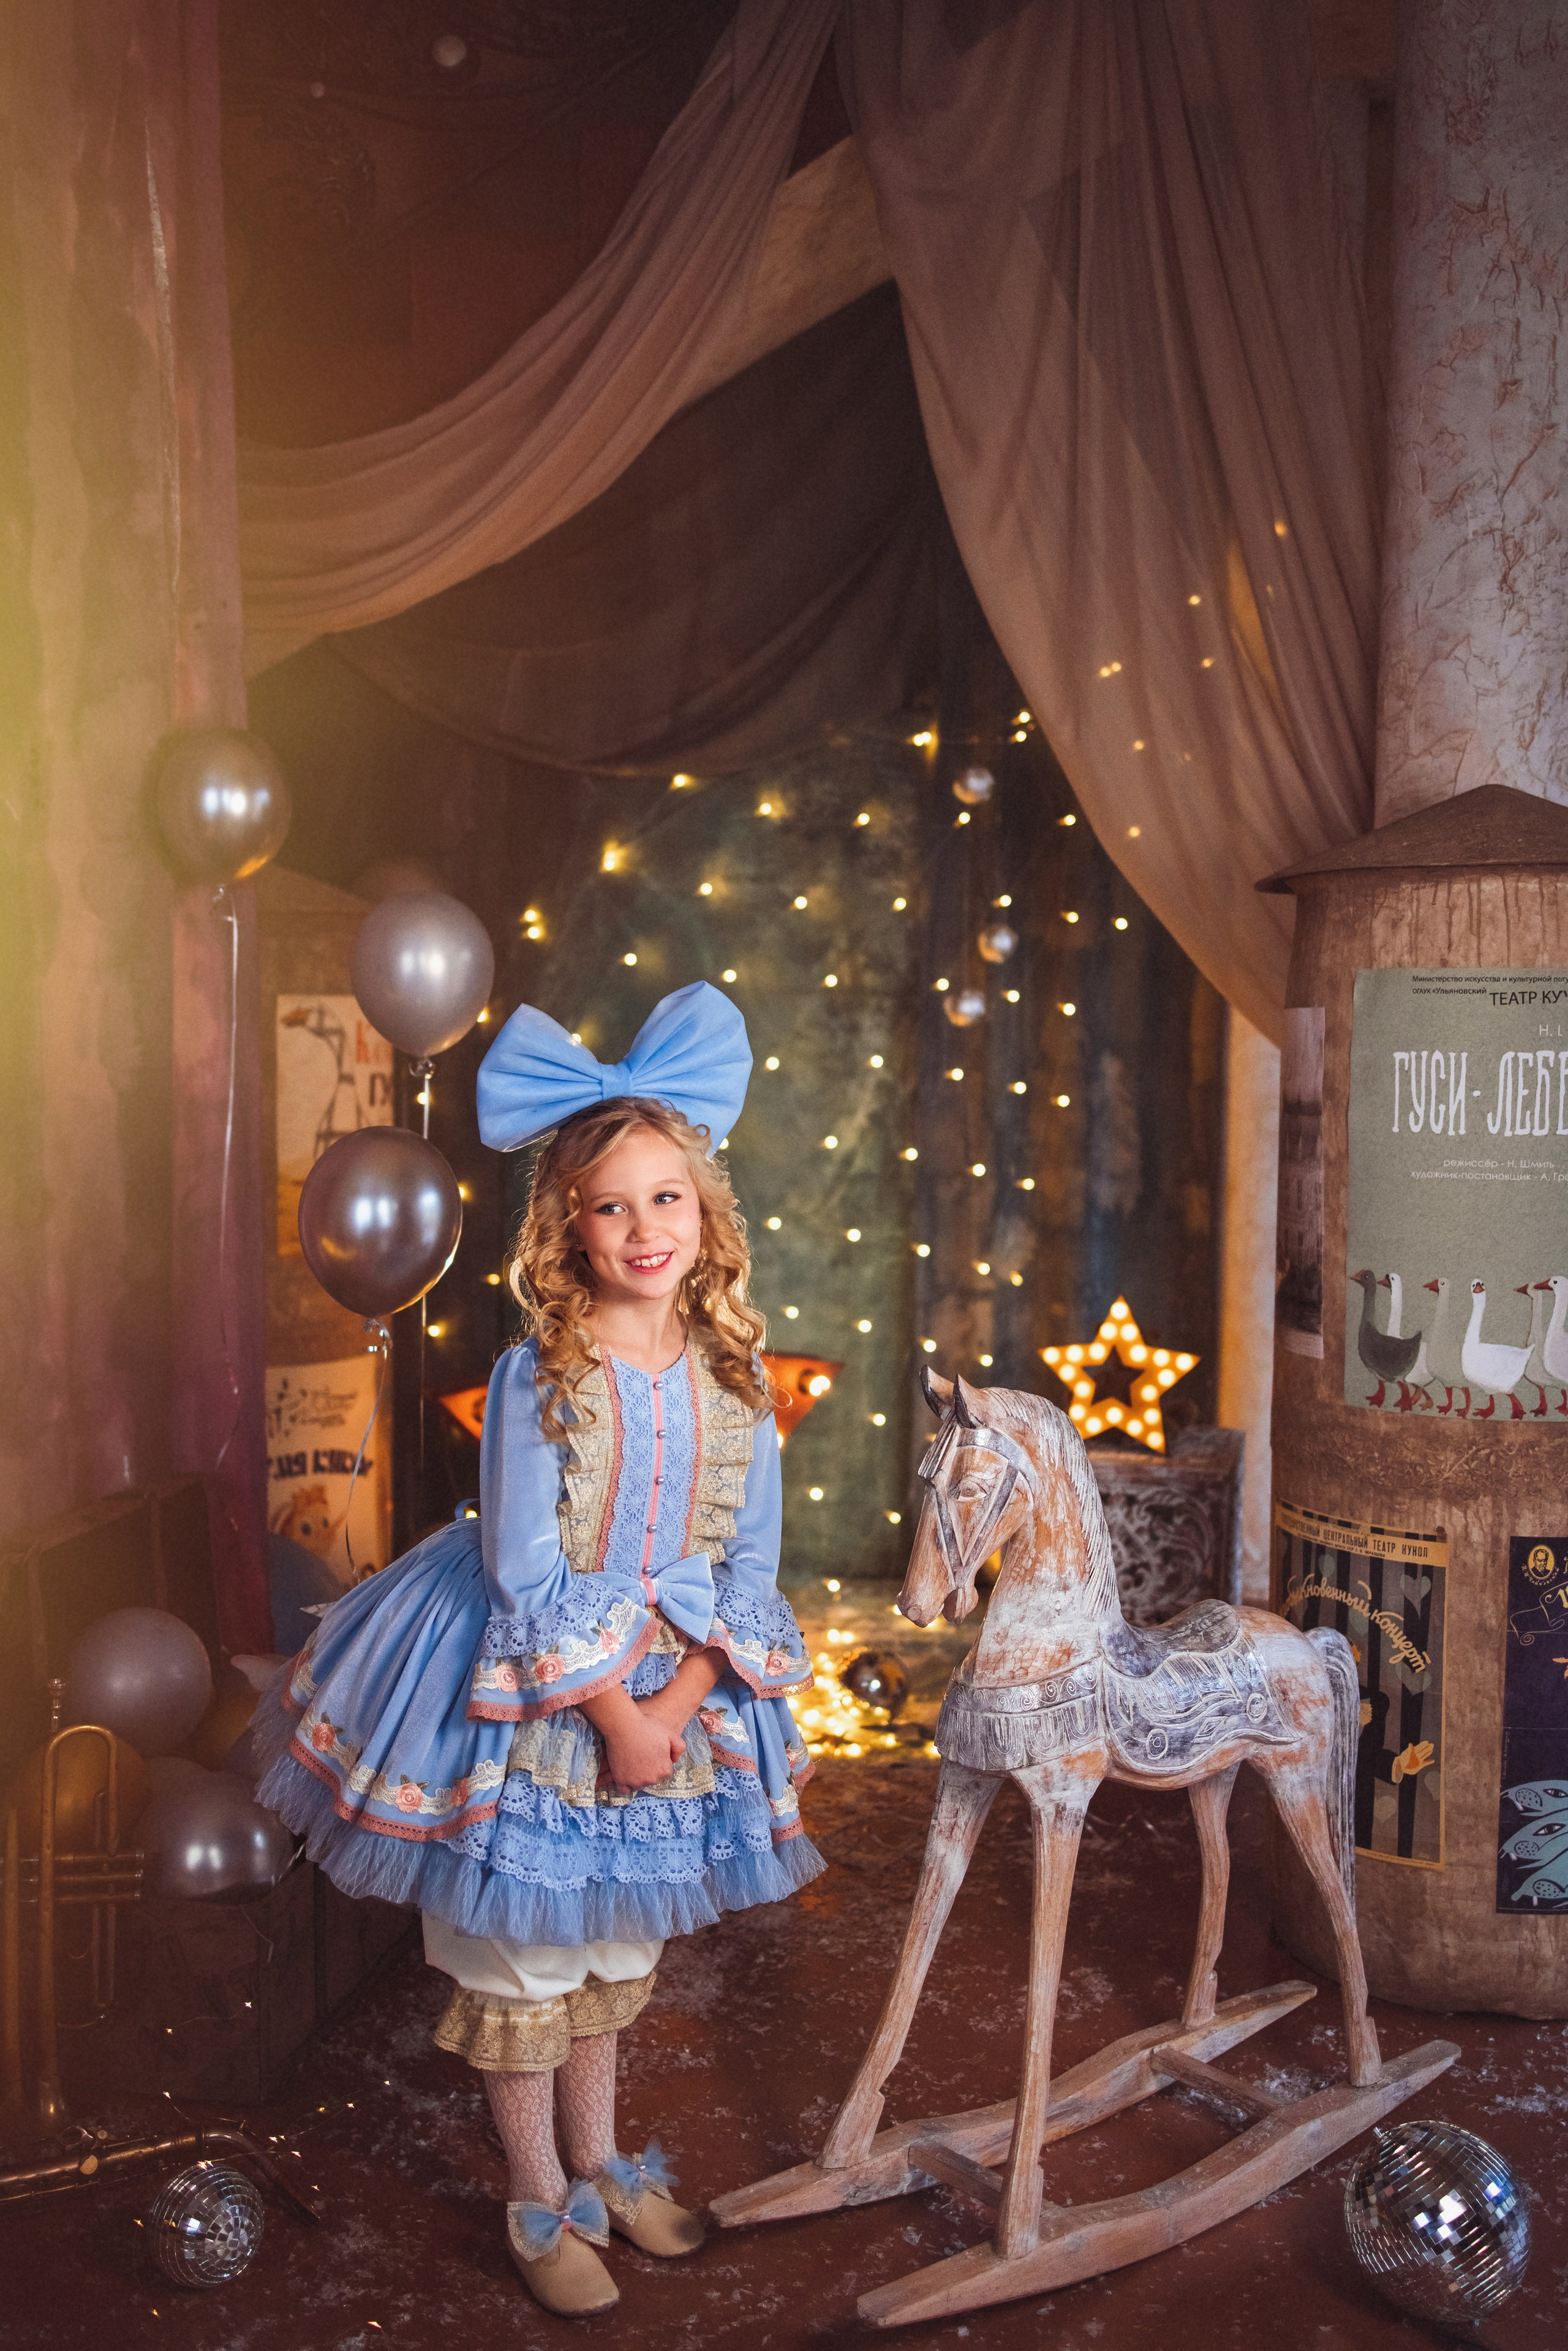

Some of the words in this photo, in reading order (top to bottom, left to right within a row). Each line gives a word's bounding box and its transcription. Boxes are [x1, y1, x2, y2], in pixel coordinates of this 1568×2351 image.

[1509, 975, 1552, 984] культурной
[1489, 991, 1537, 1006] ТЕАТР
[1539, 1024, 1553, 1036] Н.
[1443, 1158, 1498, 1169] режиссёр
[1411, 1170, 1531, 1181] художник-постановщик
[1540, 1172, 1551, 1181] А.
[1322, 1528, 1368, 1549] ЦЕНТРАЛЬНЫЙ
[1373, 1539, 1396, 1554] ТЕАТР
